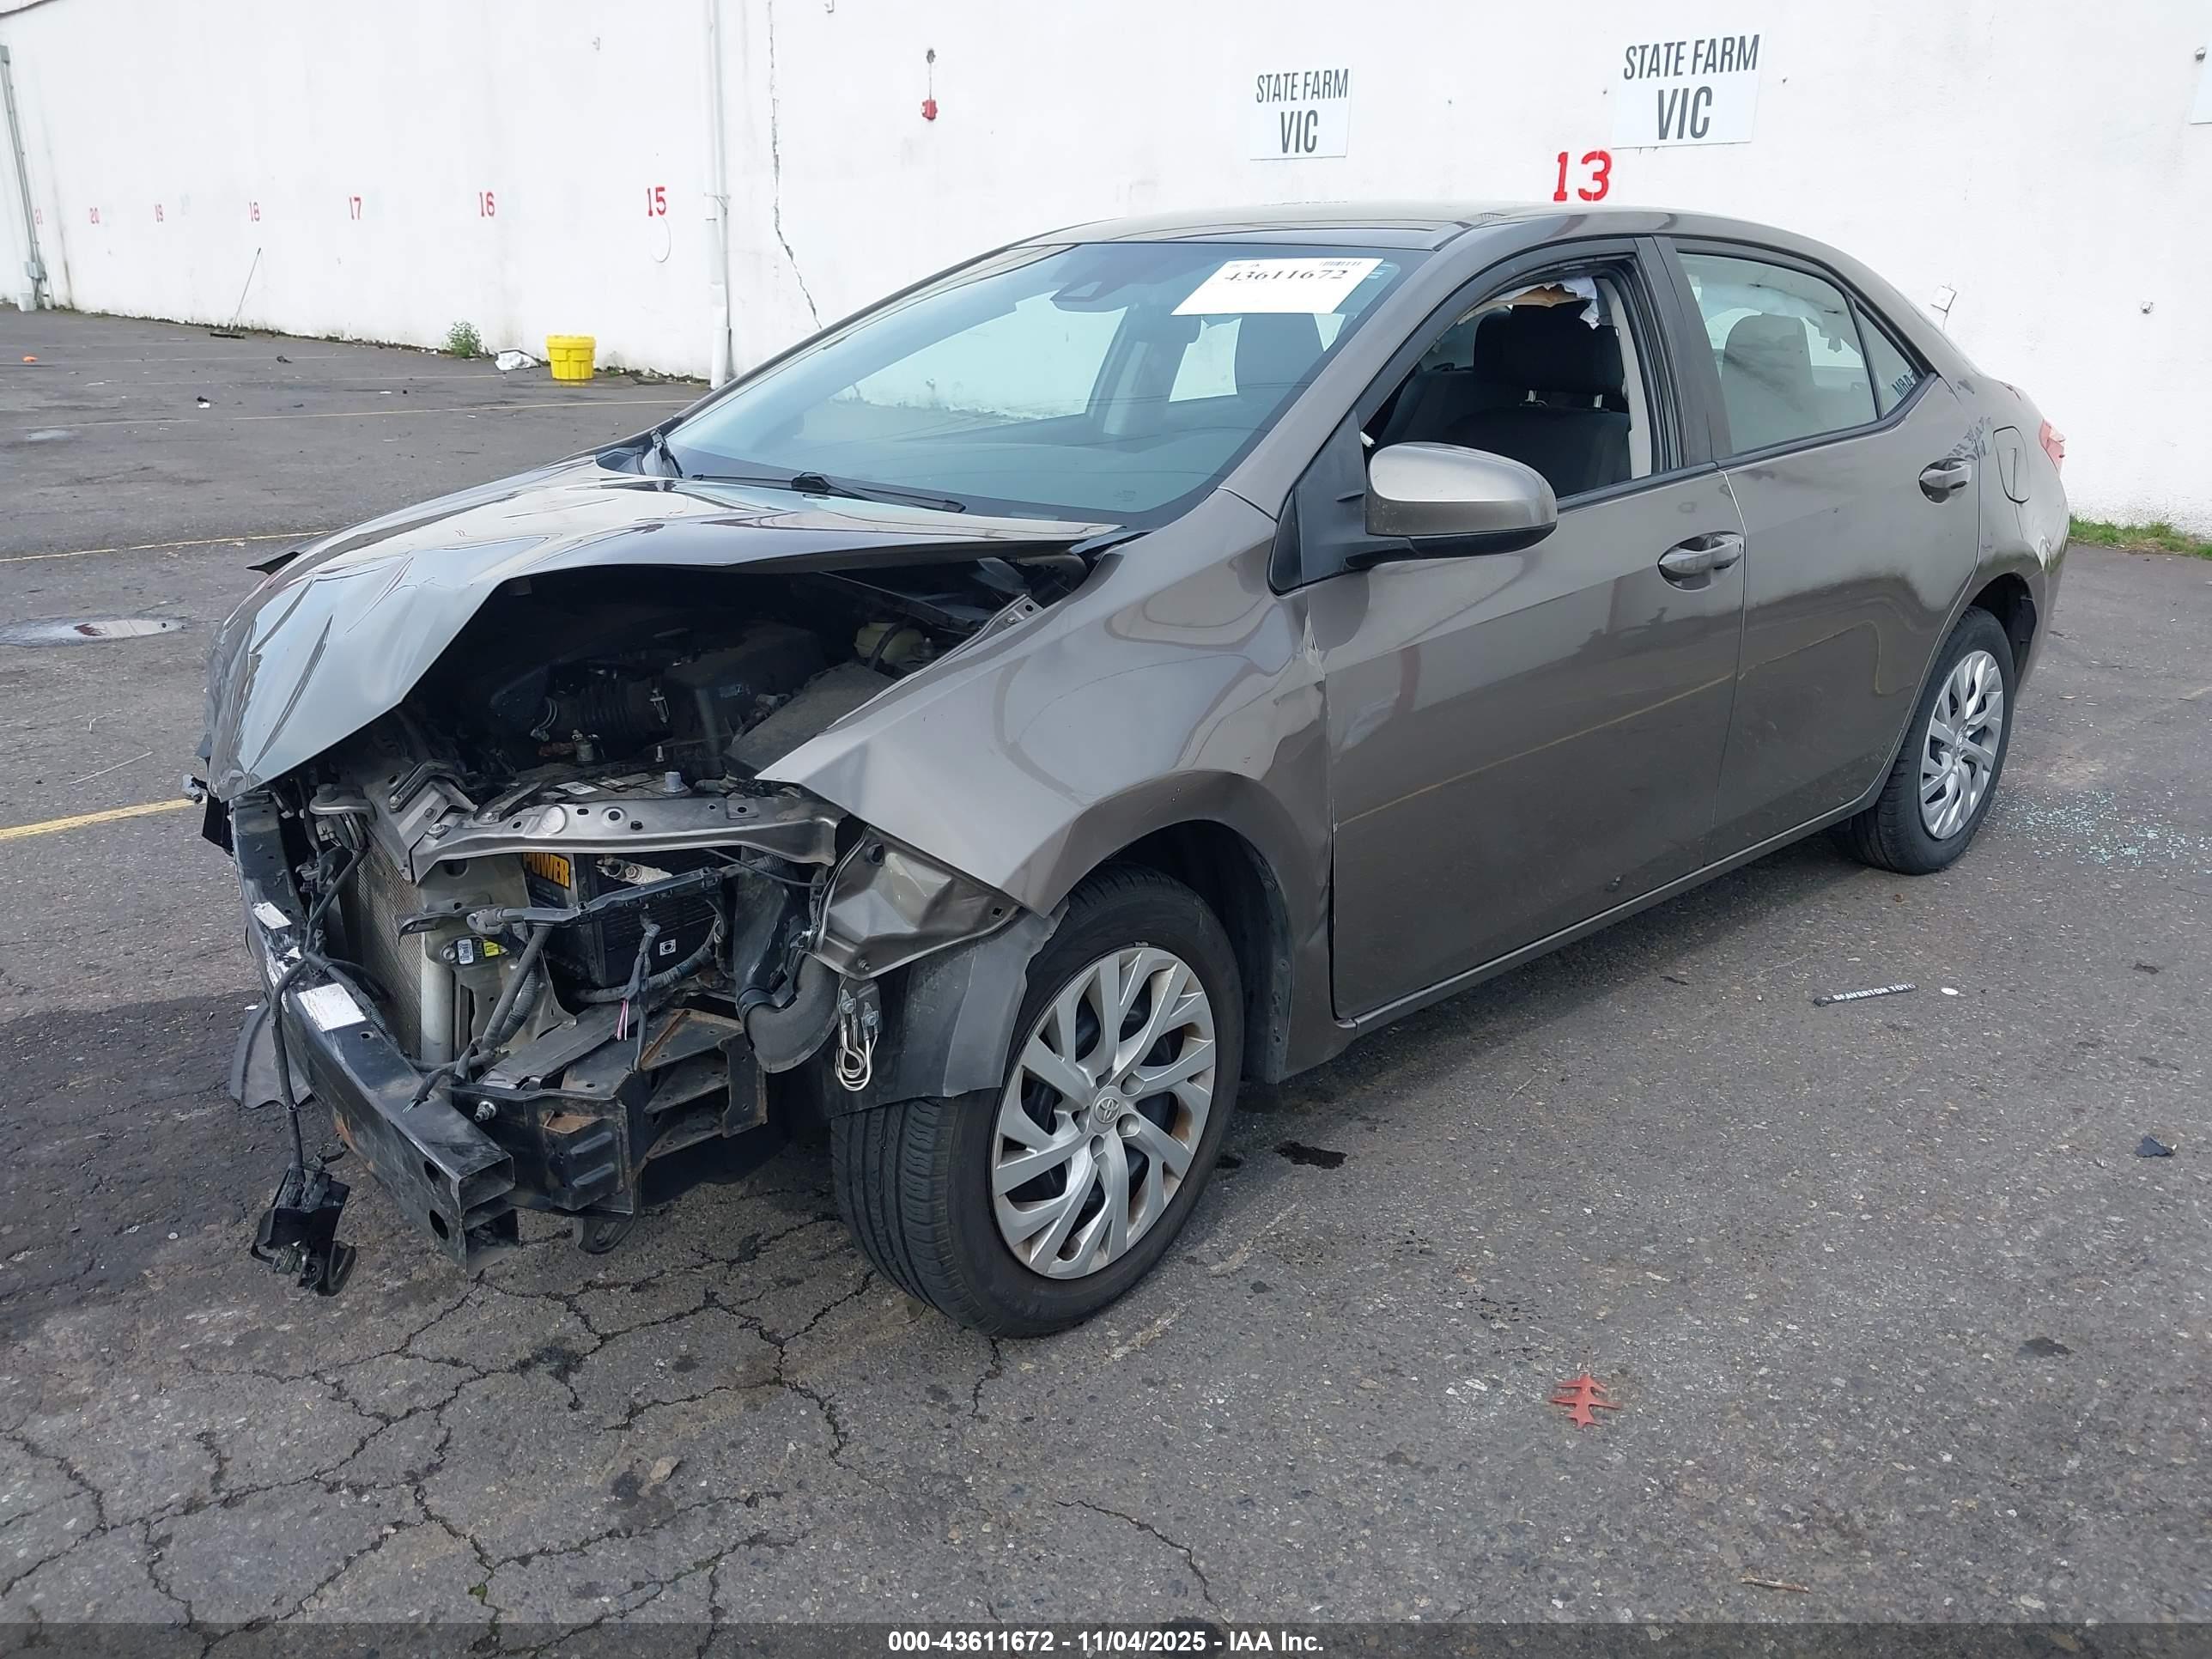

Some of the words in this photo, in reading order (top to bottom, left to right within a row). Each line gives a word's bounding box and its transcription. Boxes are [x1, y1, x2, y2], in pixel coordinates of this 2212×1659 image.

[1624, 41, 1686, 80] STATE
[1691, 34, 1759, 75] FARM
[1256, 72, 1299, 103] STATE
[1303, 69, 1349, 100] FARM
[1658, 87, 1712, 140] VIC
[1280, 110, 1318, 154] VIC
[1553, 150, 1613, 203] 13
[249, 201, 261, 222] 18
[349, 195, 362, 221] 17
[478, 191, 495, 217] 16
[646, 185, 667, 217] 15
[1224, 270, 1348, 281] 43611672
